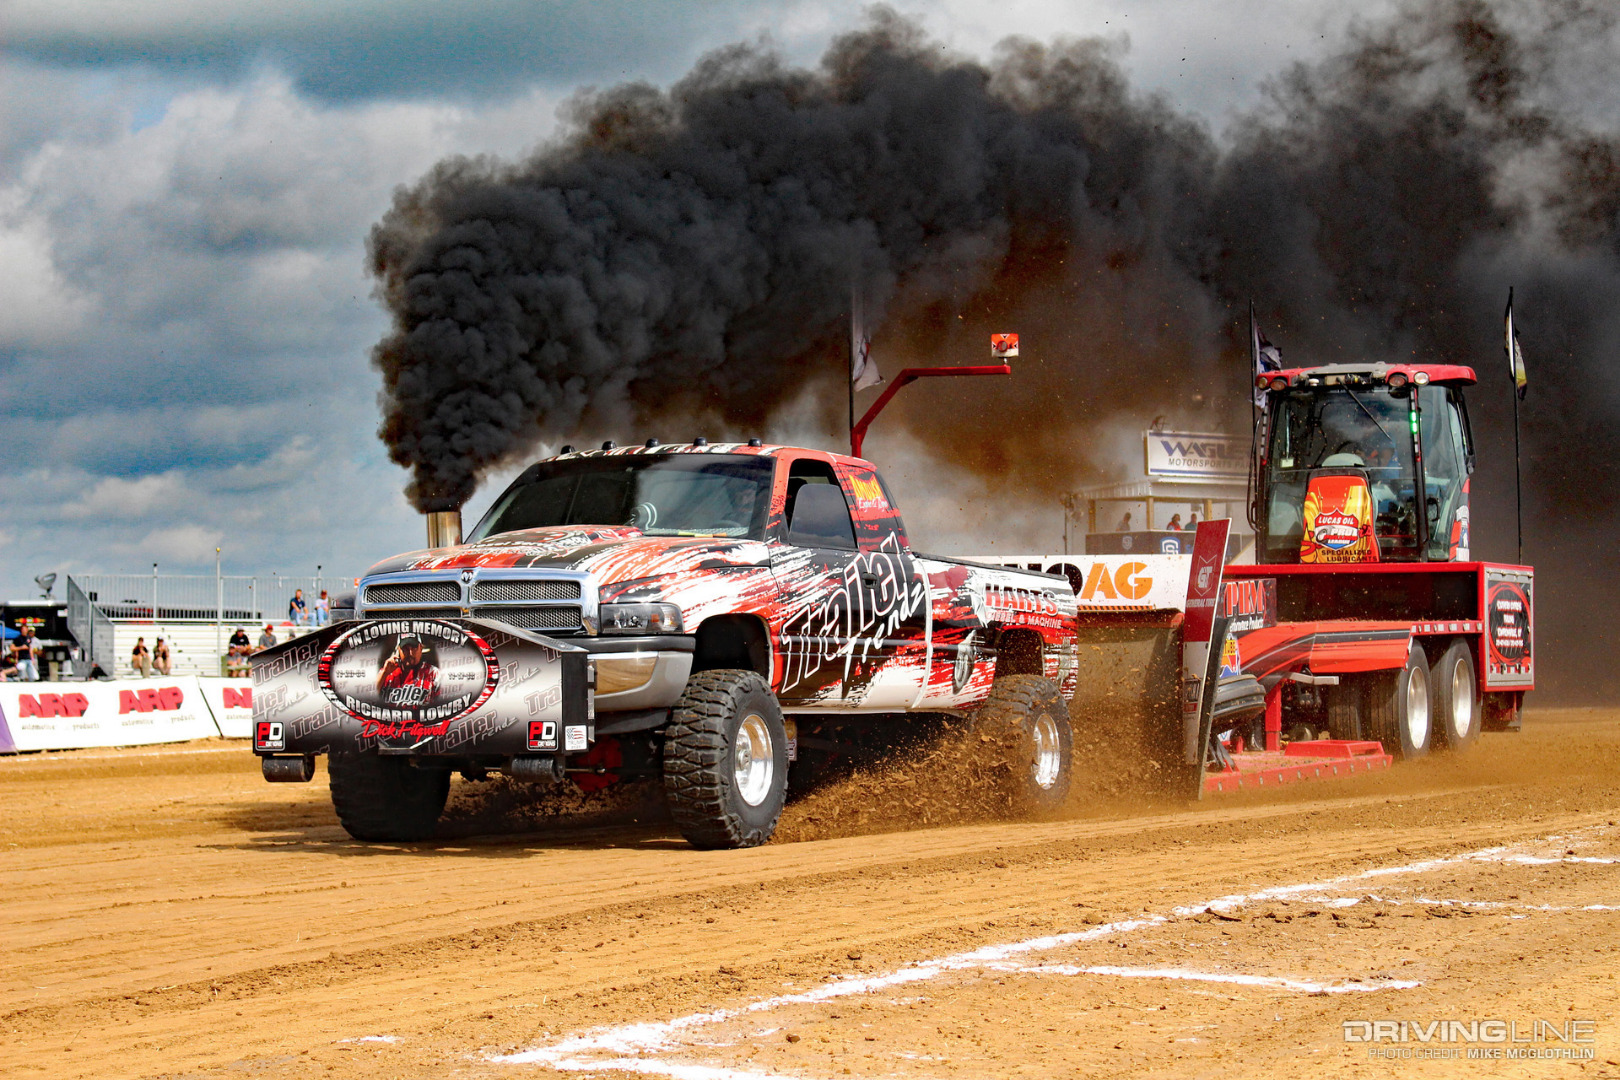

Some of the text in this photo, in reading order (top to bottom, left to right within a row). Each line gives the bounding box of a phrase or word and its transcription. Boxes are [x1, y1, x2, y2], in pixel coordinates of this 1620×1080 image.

[1318, 516, 1354, 525] LUCAS OIL
[781, 531, 907, 694] Trailer
[985, 583, 1058, 616] HARTS
[348, 633, 363, 649] IN
[364, 621, 410, 642] LOVING
[413, 620, 469, 647] MEMORY
[1027, 615, 1062, 629] MACHINE
[251, 638, 319, 687] Trailer
[19, 692, 89, 718] ARP
[119, 686, 184, 714] ARP
[345, 693, 472, 722] RICHARD LOWRY
[258, 722, 283, 740] PD
[361, 719, 396, 739] Dick
[529, 721, 556, 739] PD
